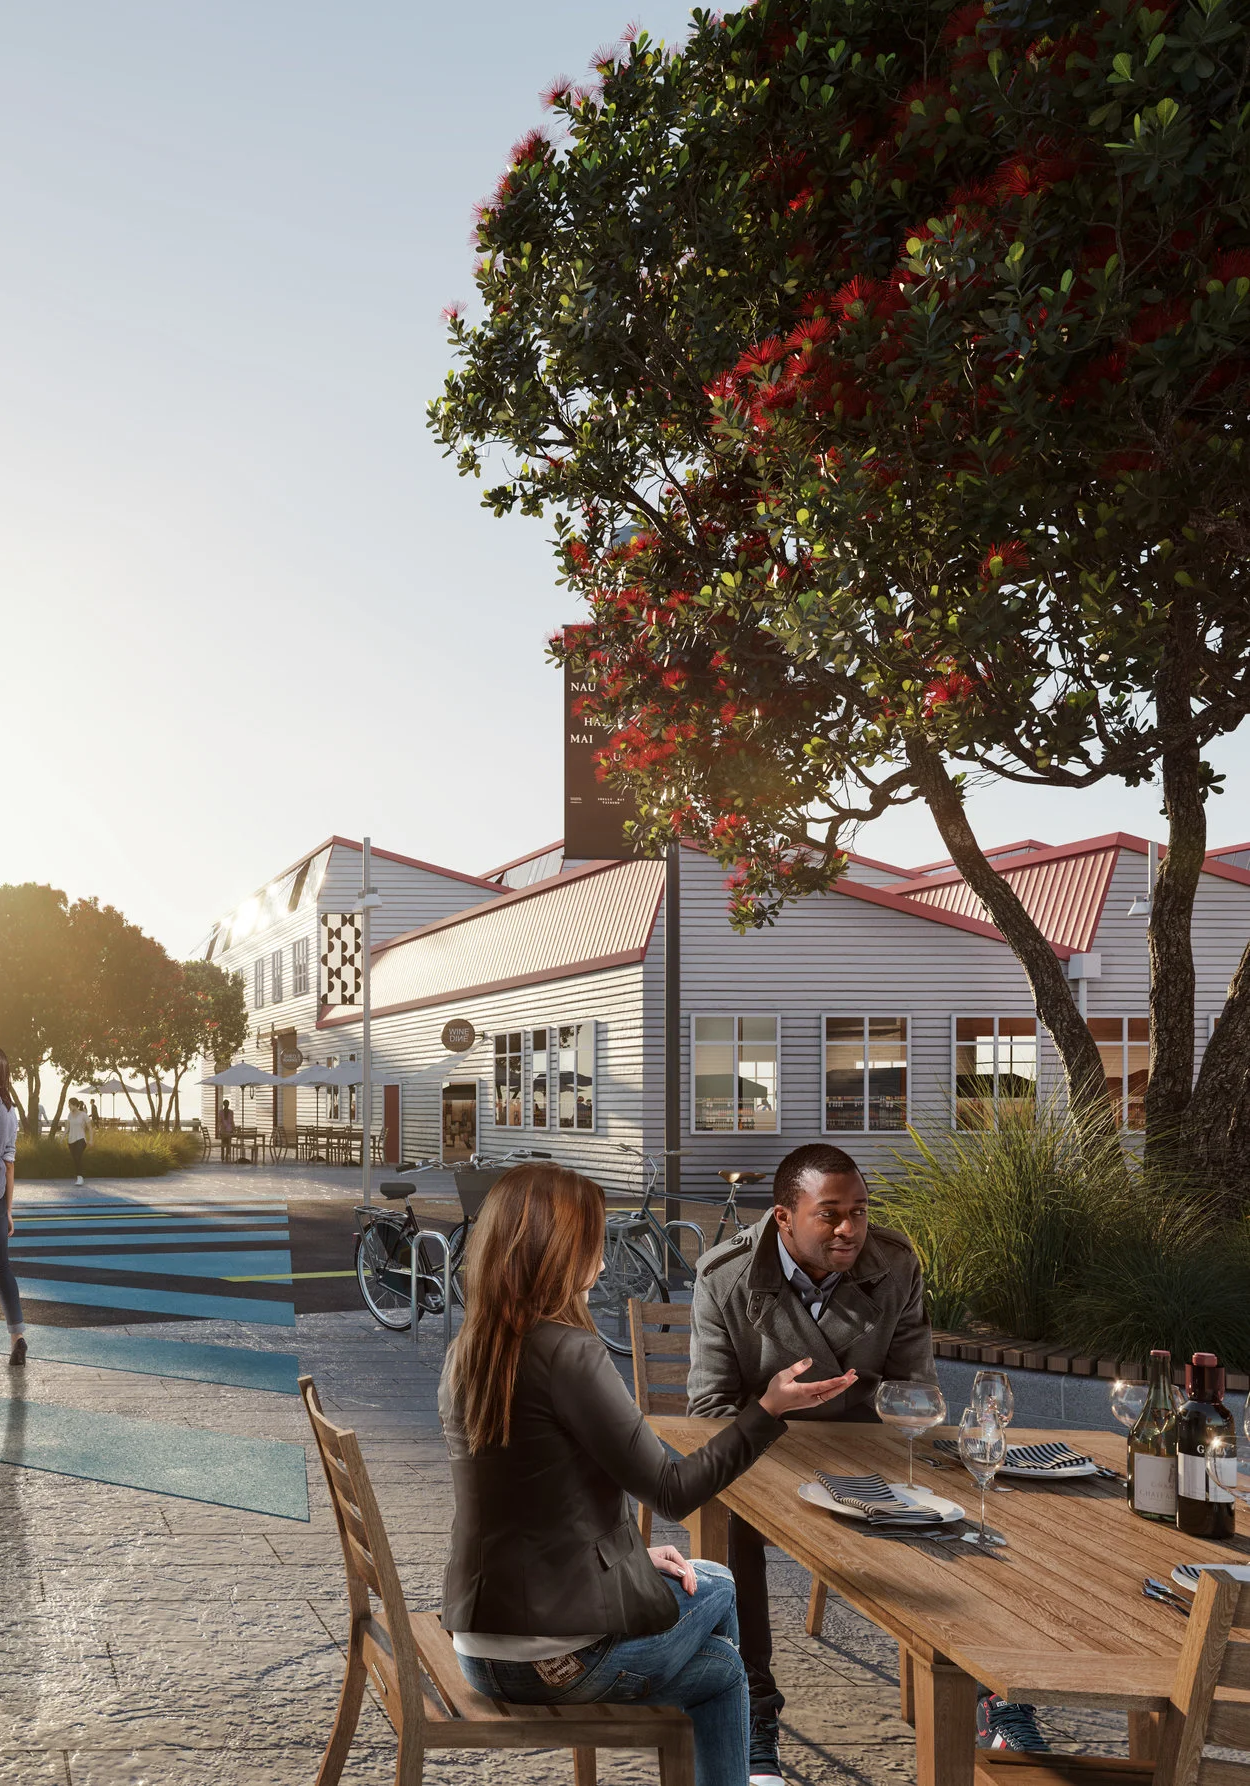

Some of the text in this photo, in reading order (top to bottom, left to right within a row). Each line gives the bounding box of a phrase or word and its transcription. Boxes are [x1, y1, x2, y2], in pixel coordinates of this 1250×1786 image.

[570, 682, 596, 692] NAU
[570, 734, 593, 744] MAI
[448, 1028, 470, 1036] WINE
